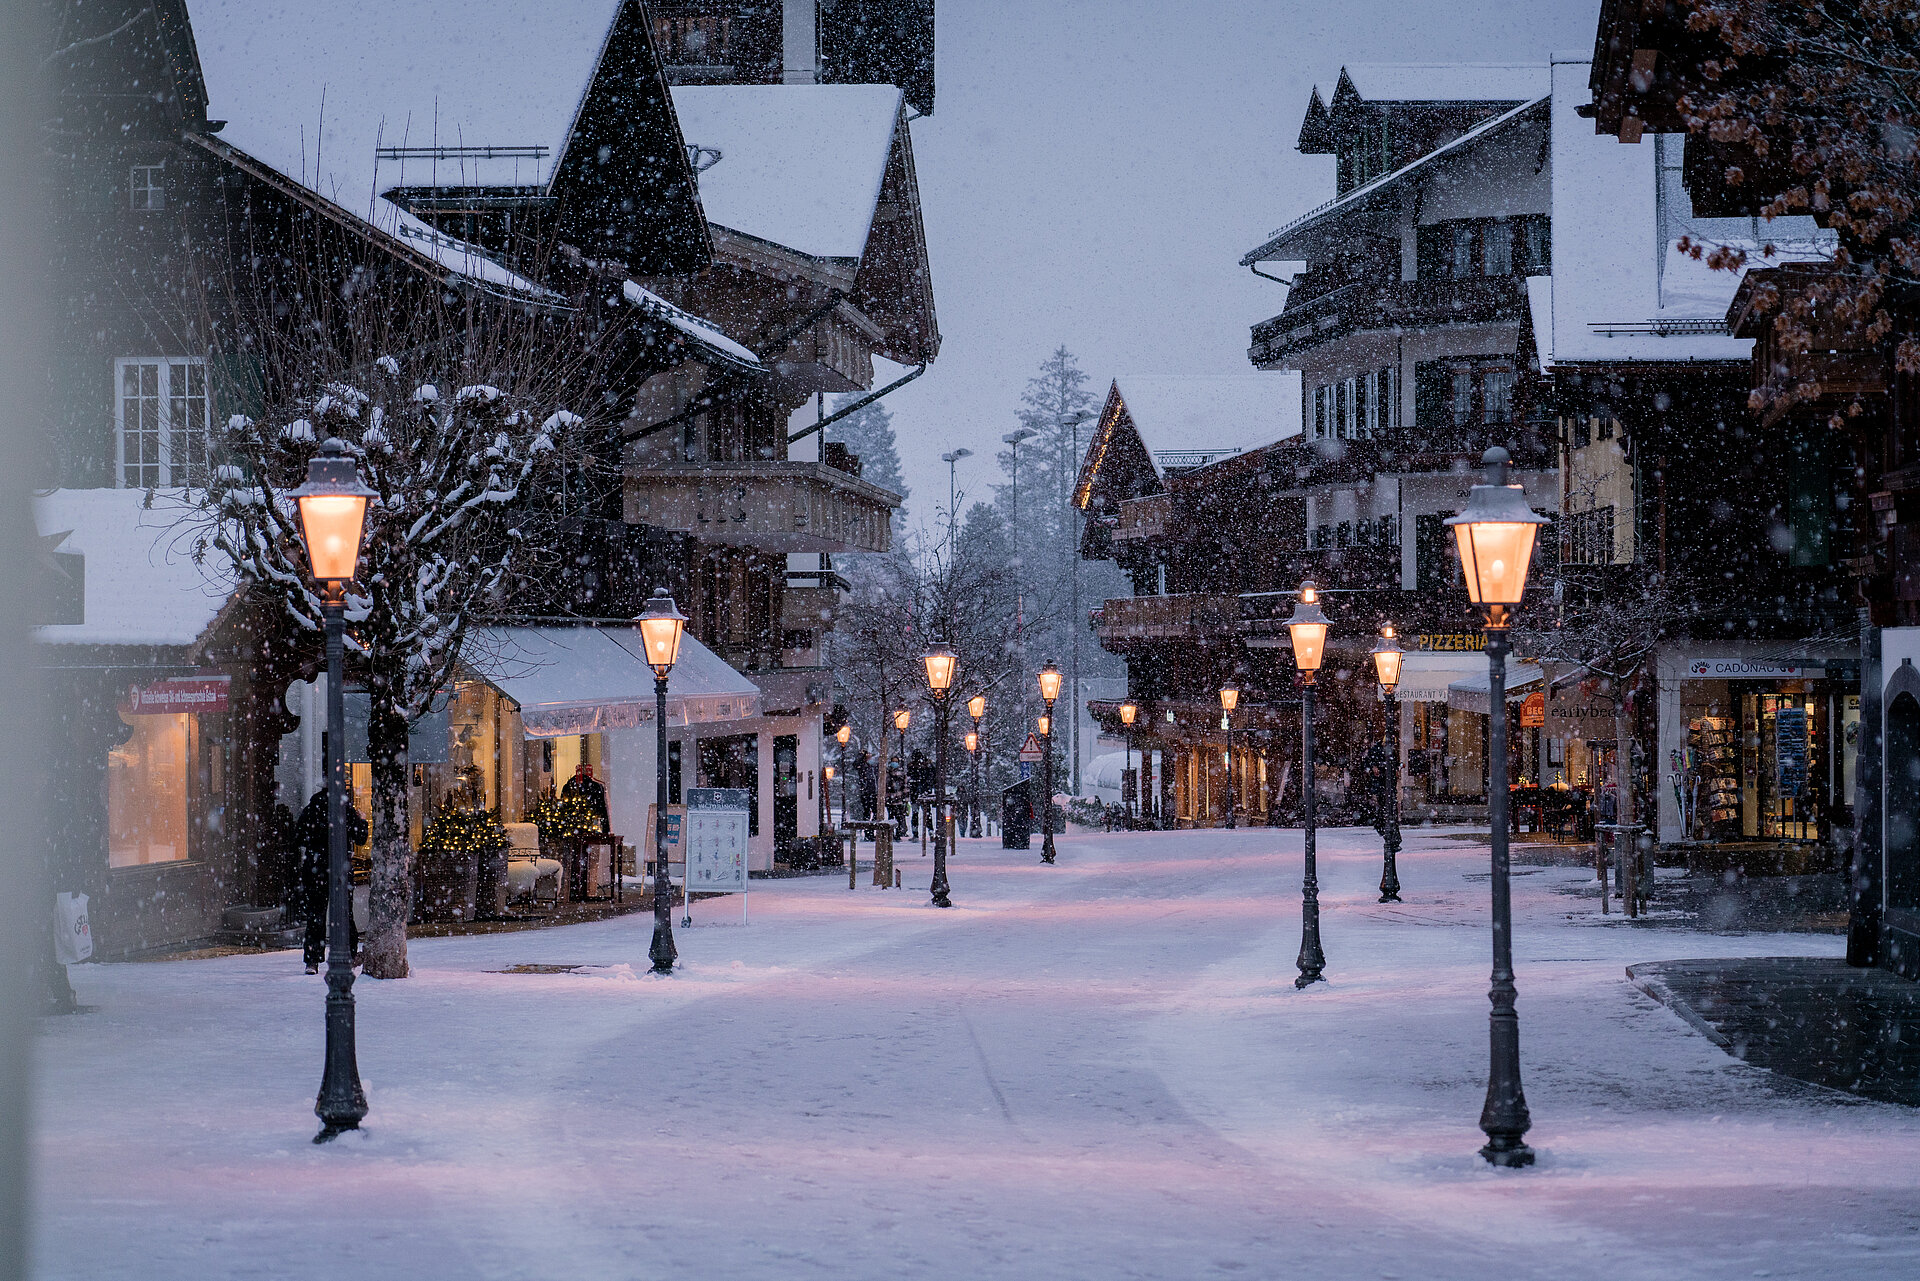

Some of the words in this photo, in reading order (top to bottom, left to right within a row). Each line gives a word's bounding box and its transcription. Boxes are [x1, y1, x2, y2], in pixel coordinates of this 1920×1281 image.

[1419, 634, 1489, 650] PIZZERIA
[1715, 663, 1775, 673] CADONAU
[1396, 690, 1436, 699] RESTAURANT
[1551, 703, 1616, 723] earlybec
